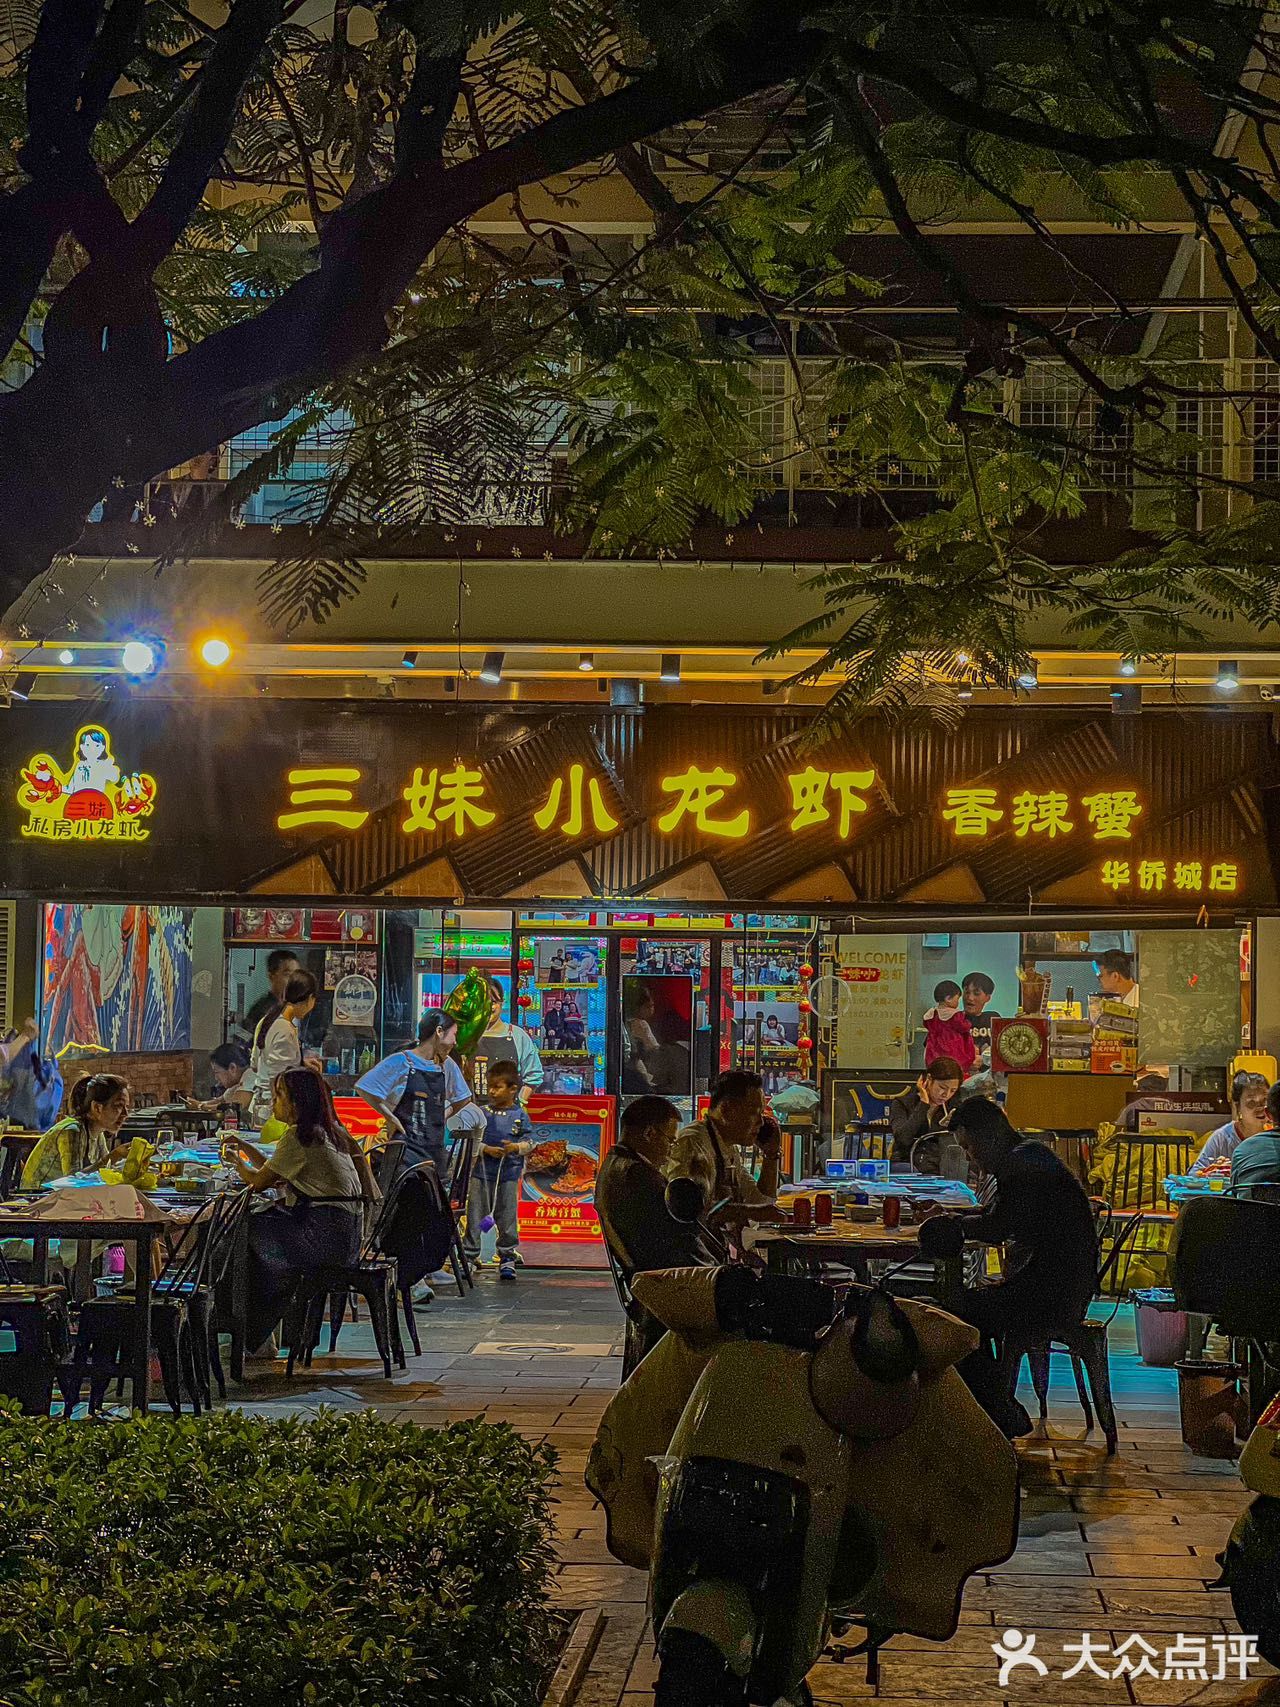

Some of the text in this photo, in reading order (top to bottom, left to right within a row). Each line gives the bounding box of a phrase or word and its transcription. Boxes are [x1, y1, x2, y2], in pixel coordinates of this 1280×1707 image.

[68, 801, 107, 817] 三妹
[276, 762, 1143, 841] 三妹小龙虾 香辣蟹
[24, 817, 146, 836] 私房小龙虾
[1100, 860, 1239, 892] 华侨城店
[837, 952, 906, 964] WELCOME
[535, 1206, 582, 1218] 香辣仔蟹
